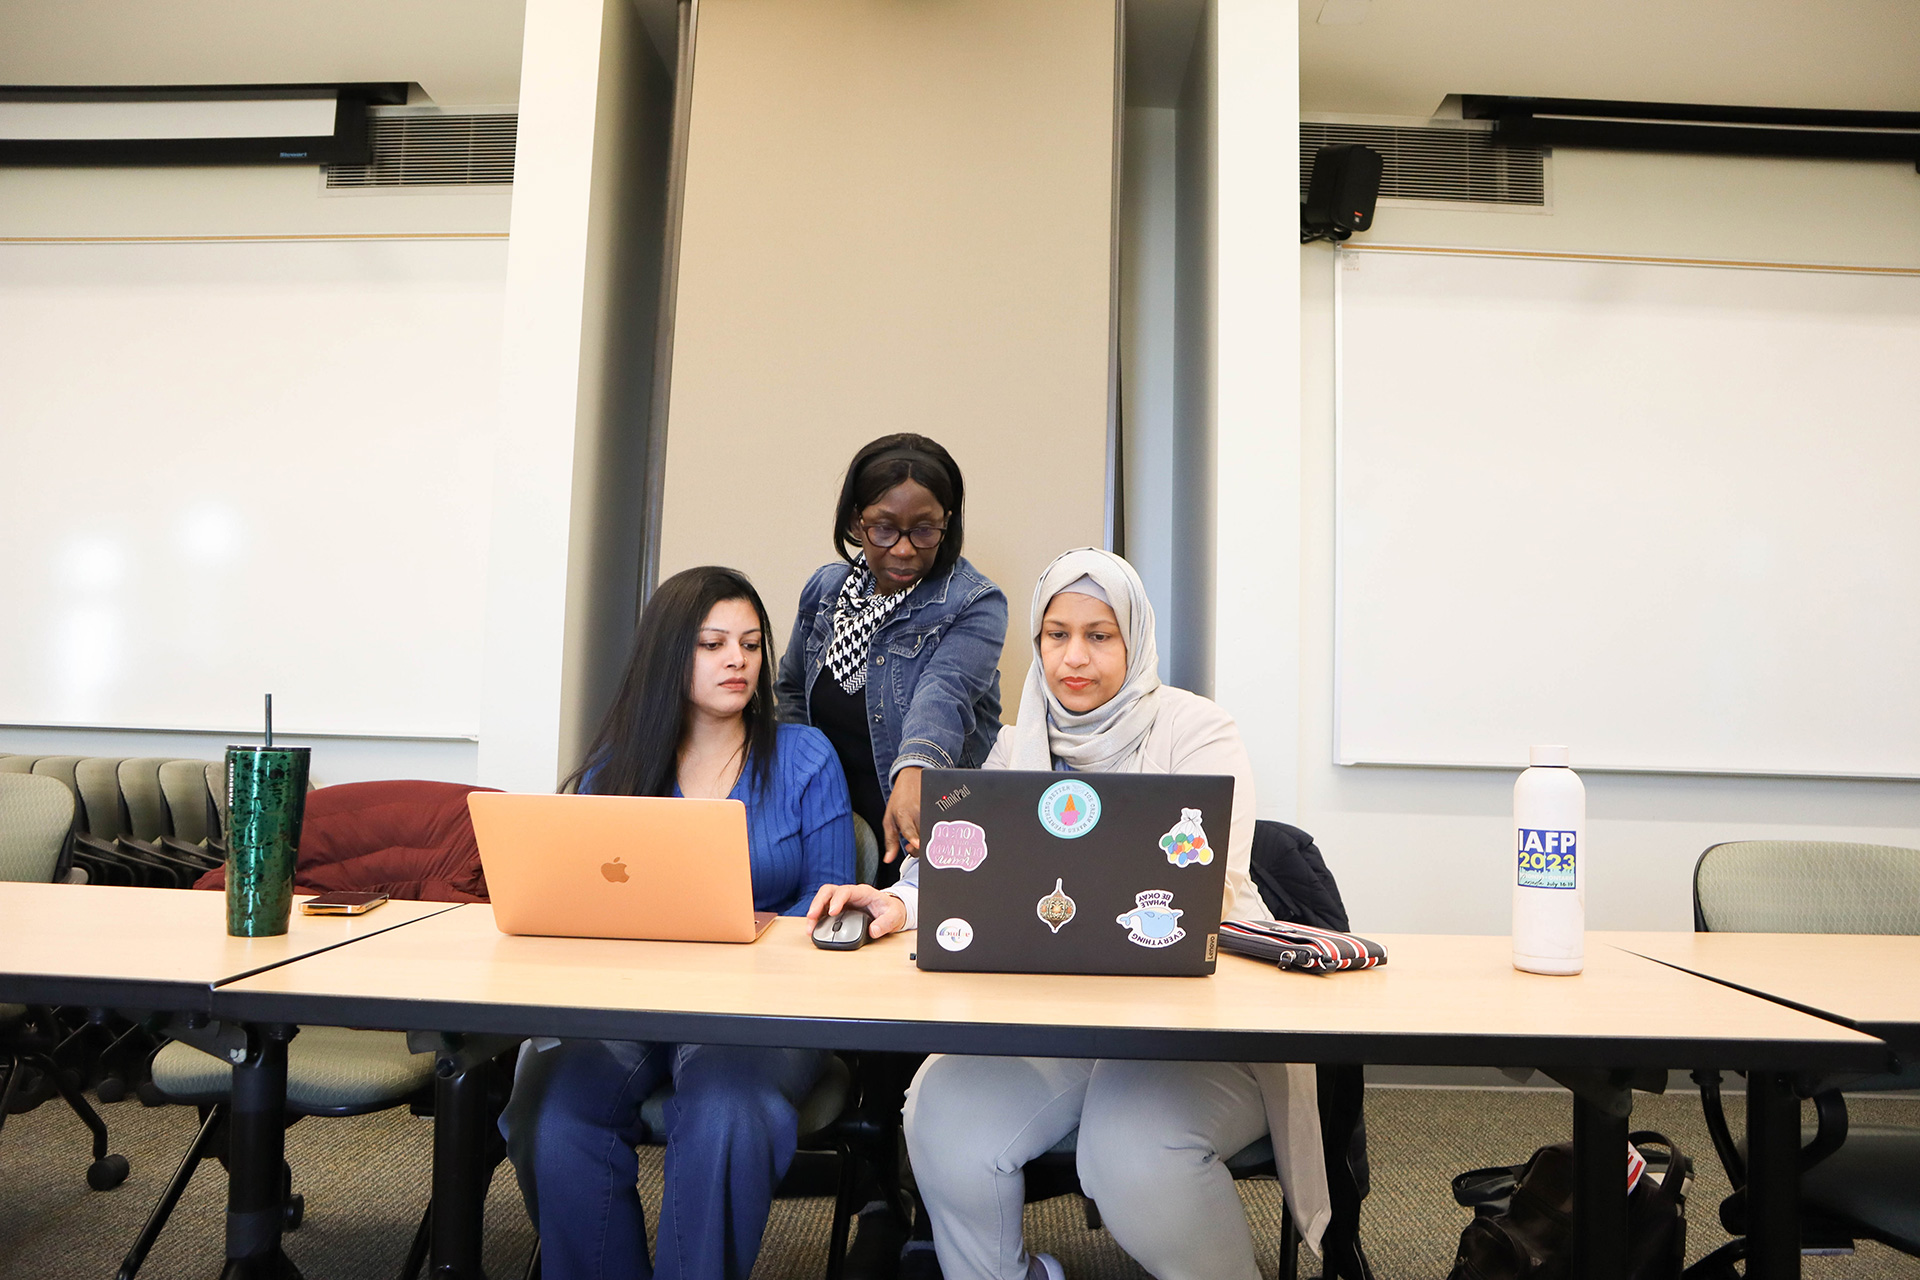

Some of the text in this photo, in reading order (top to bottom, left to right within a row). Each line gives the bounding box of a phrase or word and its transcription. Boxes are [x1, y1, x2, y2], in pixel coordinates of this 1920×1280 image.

[935, 783, 971, 811] ThinkPad
[1049, 785, 1070, 800] BETTER
[1518, 830, 1576, 853] IAFP
[1518, 851, 1576, 870] 2023
[1138, 892, 1172, 902] BE OKAY
[1140, 900, 1167, 908] WHALE
[1131, 930, 1184, 946] EVERYTHING
[1207, 936, 1215, 960] Lenovo
